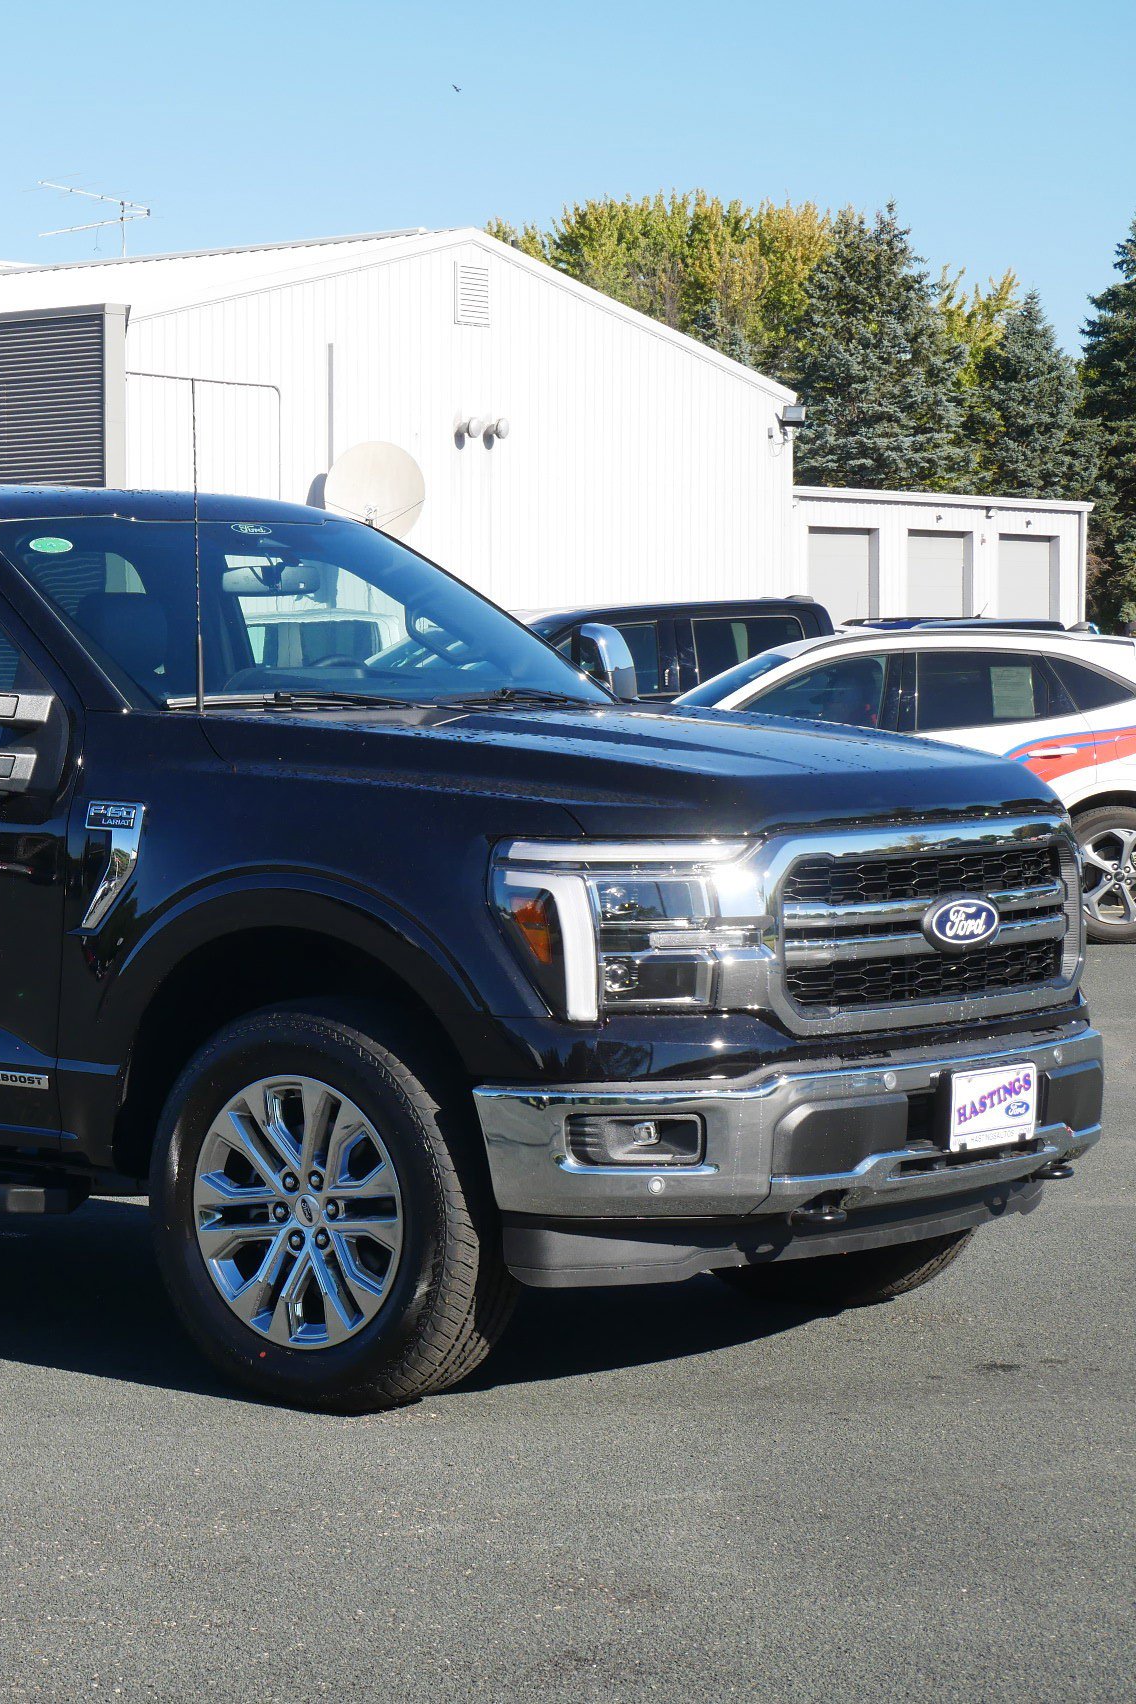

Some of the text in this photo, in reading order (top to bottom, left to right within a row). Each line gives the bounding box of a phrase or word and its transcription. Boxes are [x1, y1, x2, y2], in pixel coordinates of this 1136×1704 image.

[90, 805, 136, 818] F-150
[102, 818, 130, 826] LARIAT
[946, 906, 986, 937] Ford
[956, 1072, 1032, 1125] HASTINGS
